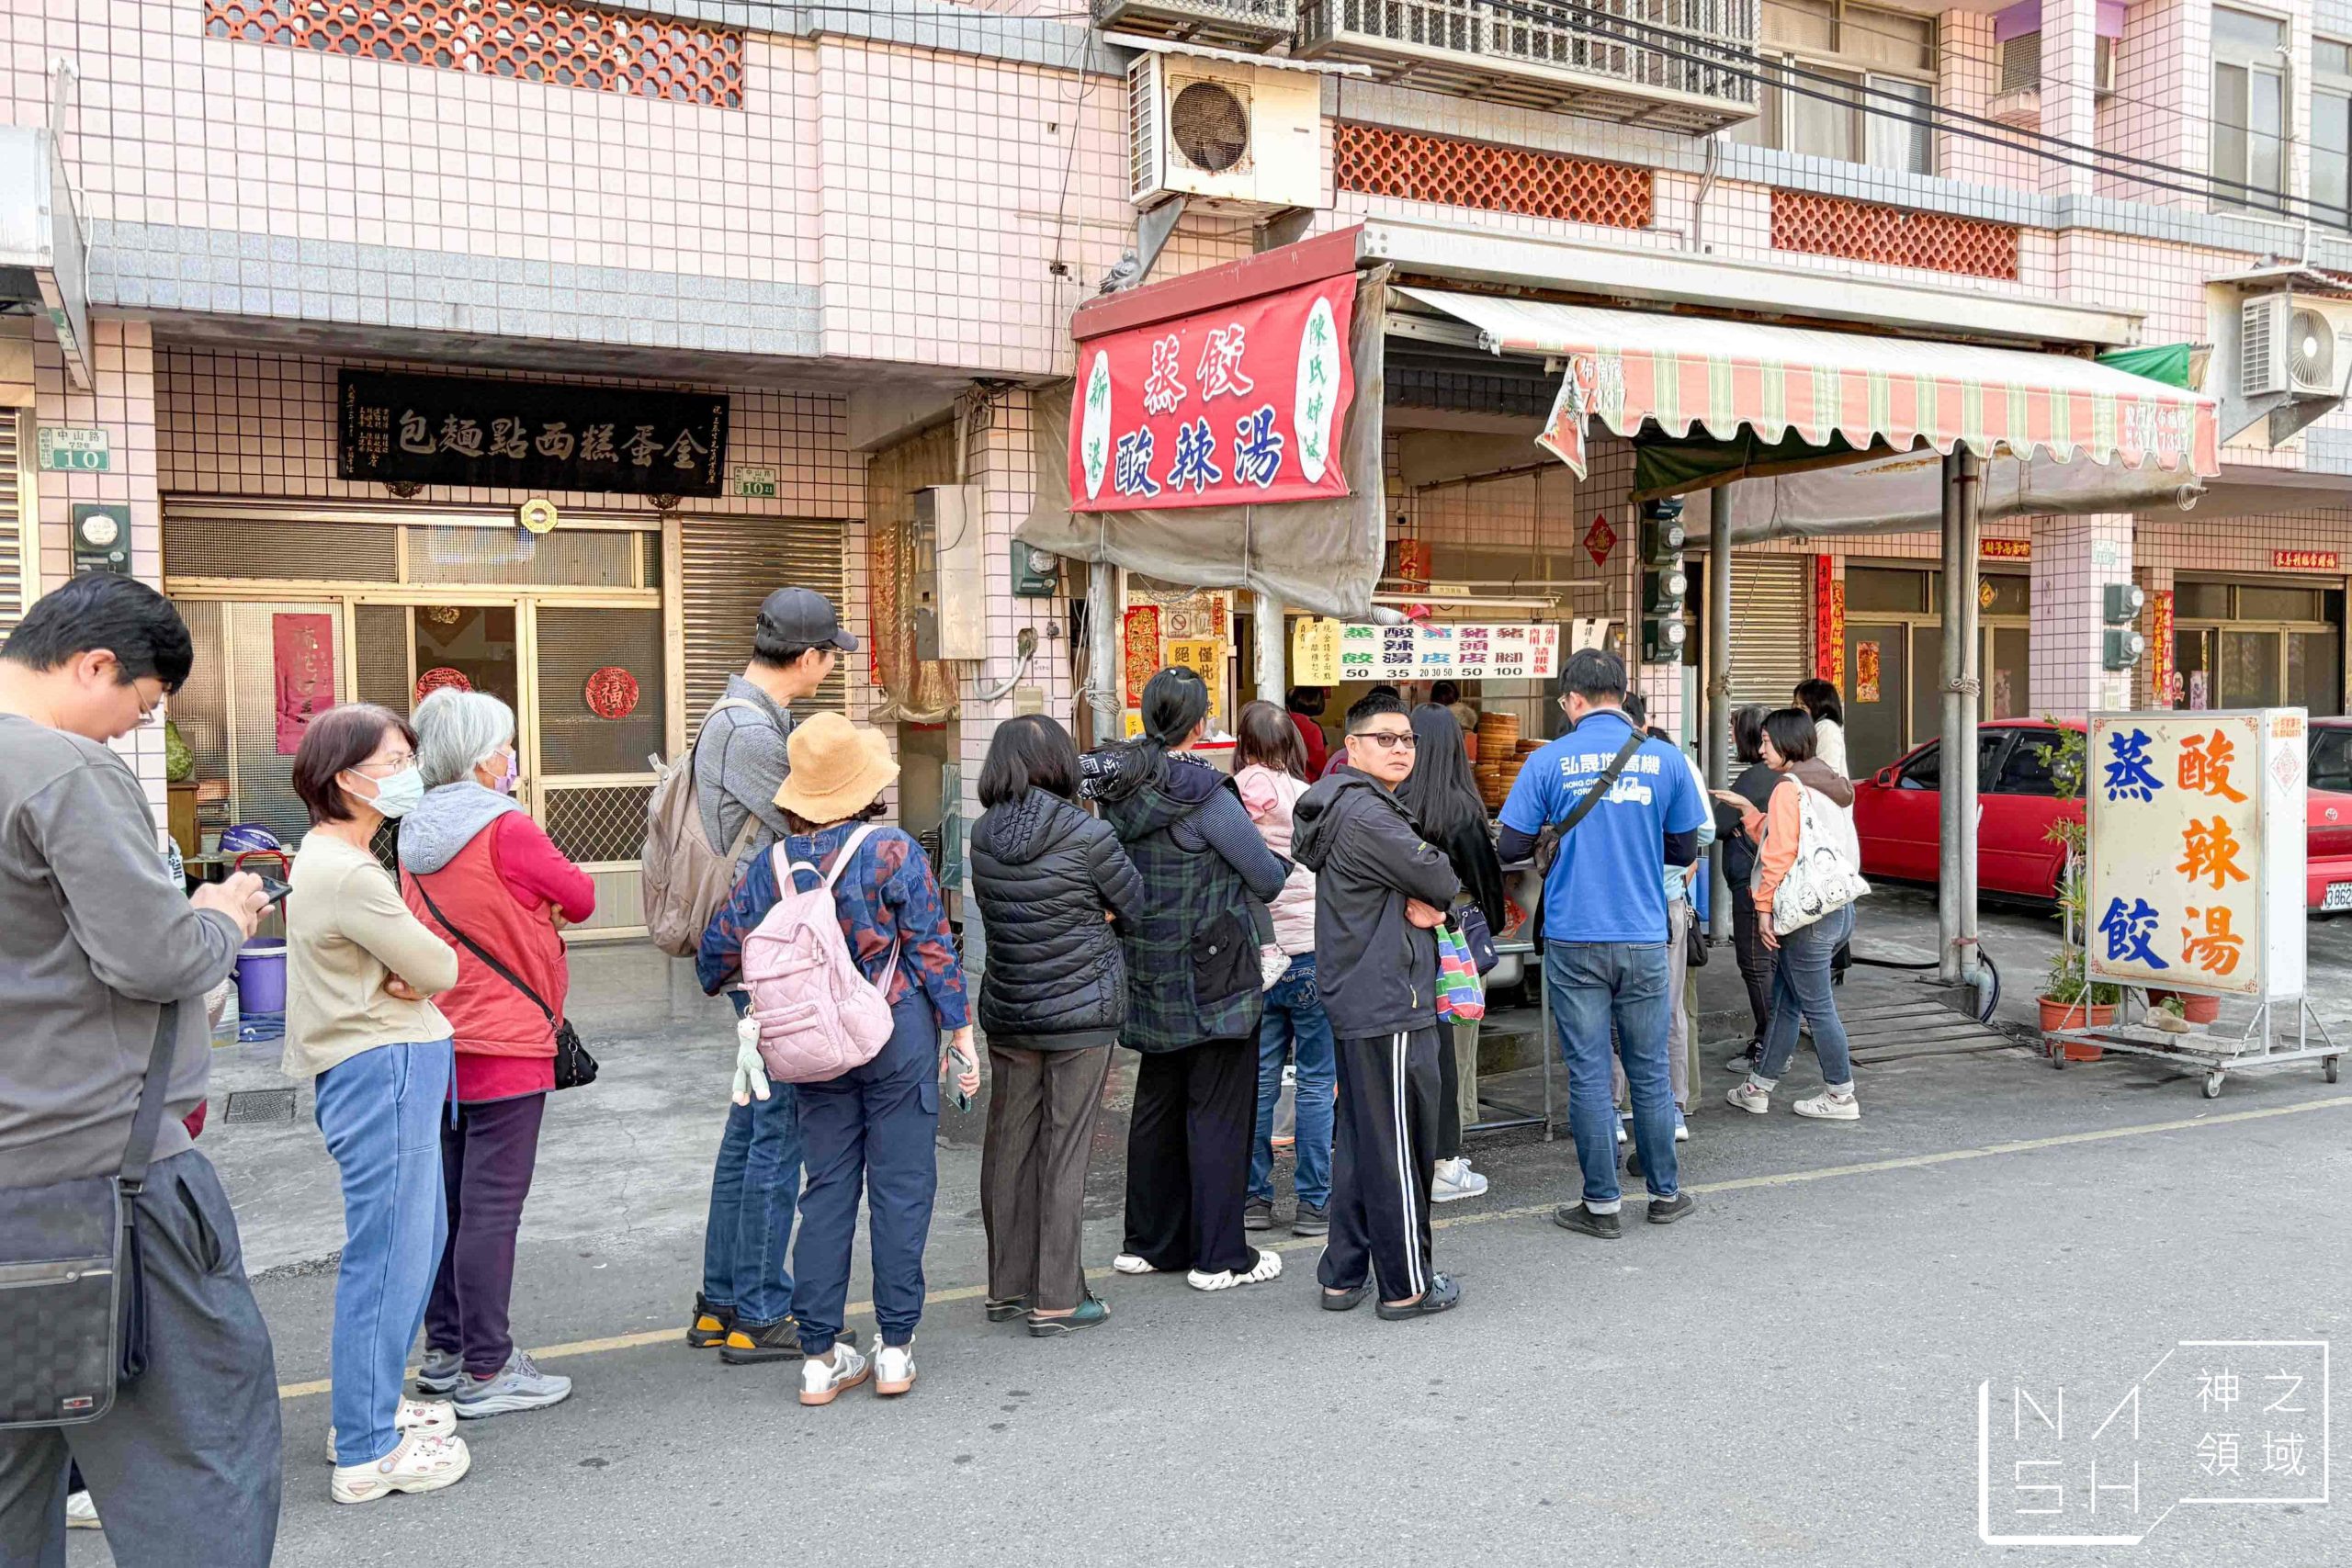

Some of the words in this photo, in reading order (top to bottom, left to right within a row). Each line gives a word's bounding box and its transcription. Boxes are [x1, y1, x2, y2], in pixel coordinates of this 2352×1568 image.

[1144, 323, 1253, 416] 蒸餃
[57, 431, 100, 442] 中山路
[1086, 369, 1111, 482] 新港
[63, 450, 100, 468] 10
[1114, 403, 1286, 500] 酸辣湯
[745, 468, 772, 477] 中山路
[744, 482, 764, 495] 10
[1341, 626, 1375, 665] 蒸餃
[1382, 627, 1415, 664] 酸辣湯
[1420, 628, 1453, 664] 豬皮
[1458, 627, 1489, 663] 豬頭皮
[1495, 627, 1525, 664] 豬腳
[1345, 669, 1370, 678] 50
[1385, 669, 1410, 678] 35
[1419, 669, 1430, 678] 20
[1431, 669, 1441, 678] 30
[1443, 669, 1453, 678] 50
[1461, 667, 1483, 677] 50
[1495, 667, 1523, 676] 100
[1563, 779, 1585, 790] HONG
[2098, 728, 2169, 969] 蒸餃
[2176, 728, 2251, 976] 酸辣湯
